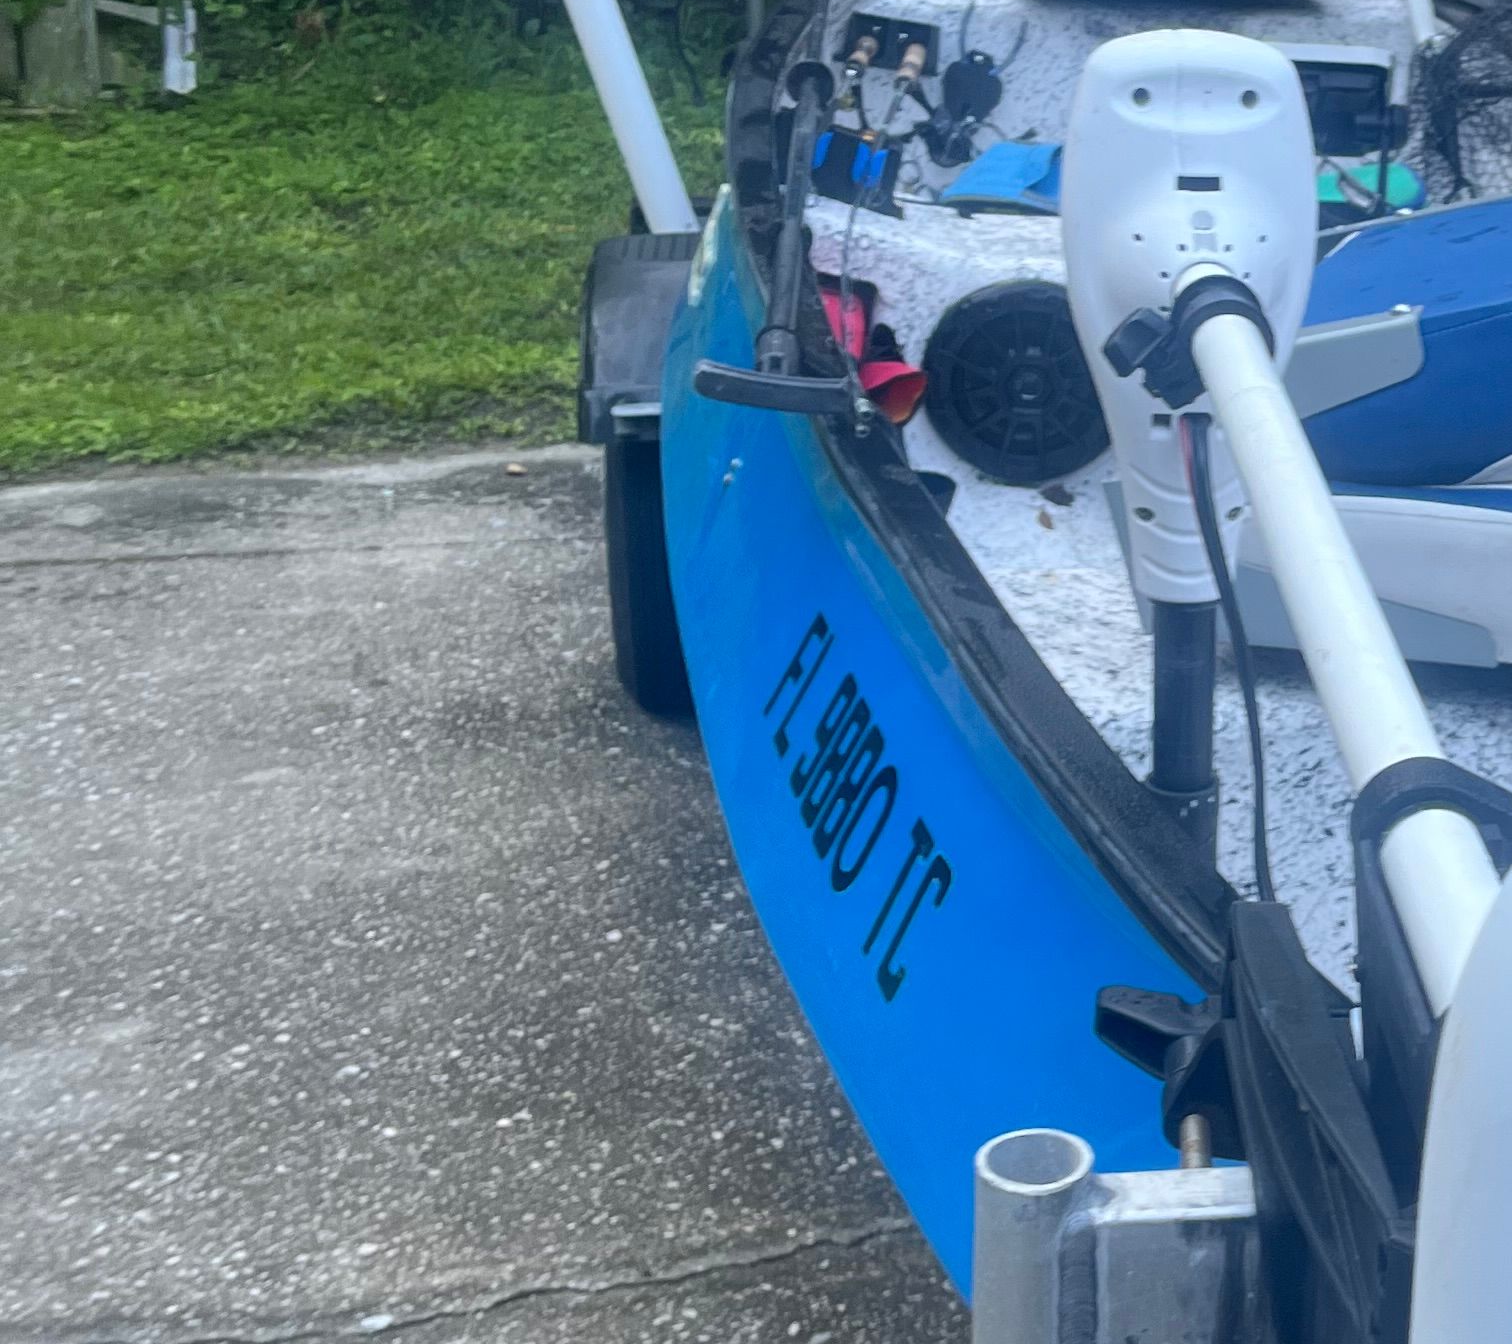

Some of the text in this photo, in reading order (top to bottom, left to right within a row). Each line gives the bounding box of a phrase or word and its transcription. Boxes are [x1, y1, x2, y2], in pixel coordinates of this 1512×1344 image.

[763, 611, 952, 1002] FL 9880 TC
